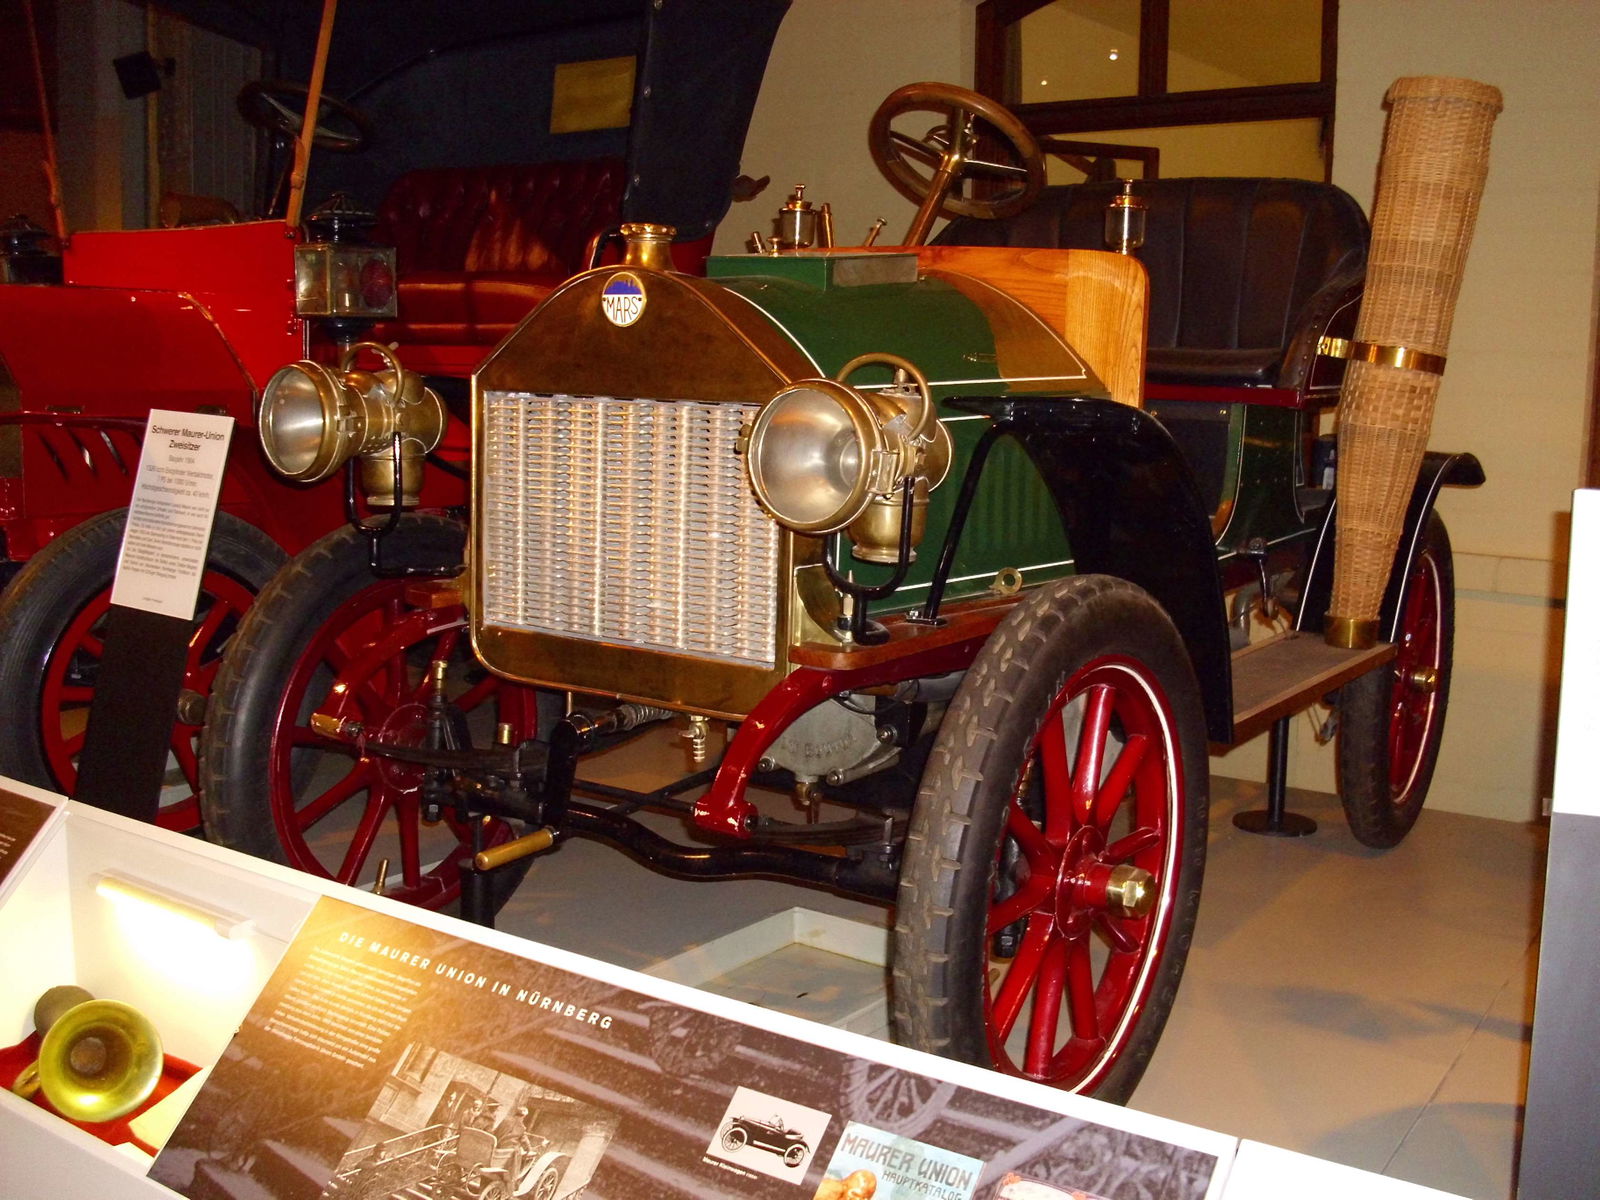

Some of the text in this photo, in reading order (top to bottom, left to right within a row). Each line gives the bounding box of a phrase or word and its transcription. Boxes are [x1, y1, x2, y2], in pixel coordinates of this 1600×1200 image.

[606, 296, 639, 323] MARS
[152, 425, 225, 440] Schwerer Maurer-Union
[169, 440, 201, 451] Zweisitzer
[339, 931, 614, 1030] DIE MAURER UNION IN NÜRNBERG
[841, 1133, 973, 1191] MAURER UNION
[882, 1170, 963, 1200] HAUPTKATALOG
